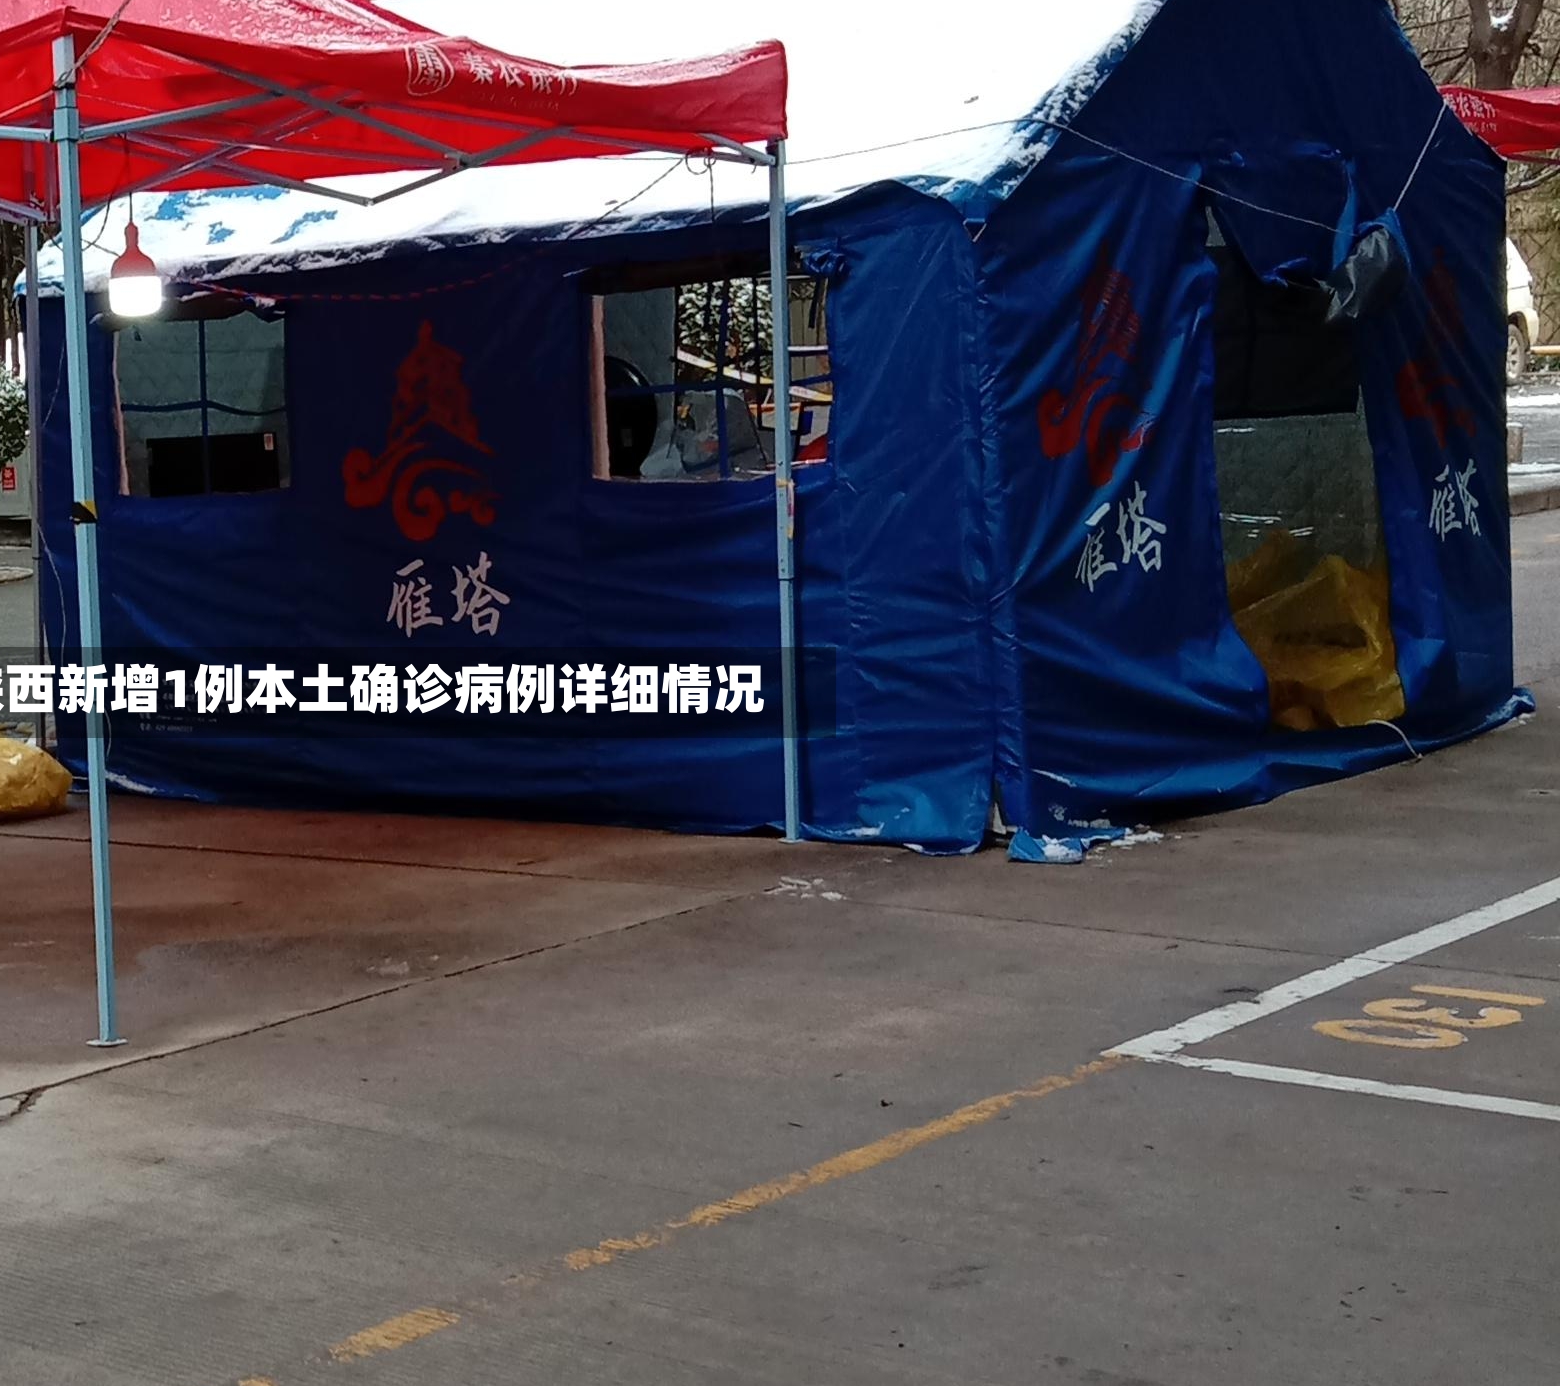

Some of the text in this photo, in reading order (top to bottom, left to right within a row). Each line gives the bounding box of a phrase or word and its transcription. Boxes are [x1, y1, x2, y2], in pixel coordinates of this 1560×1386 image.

[1074, 480, 1168, 593] 雁塔
[1428, 461, 1482, 543] 雁塔
[385, 551, 511, 638] 雁塔
